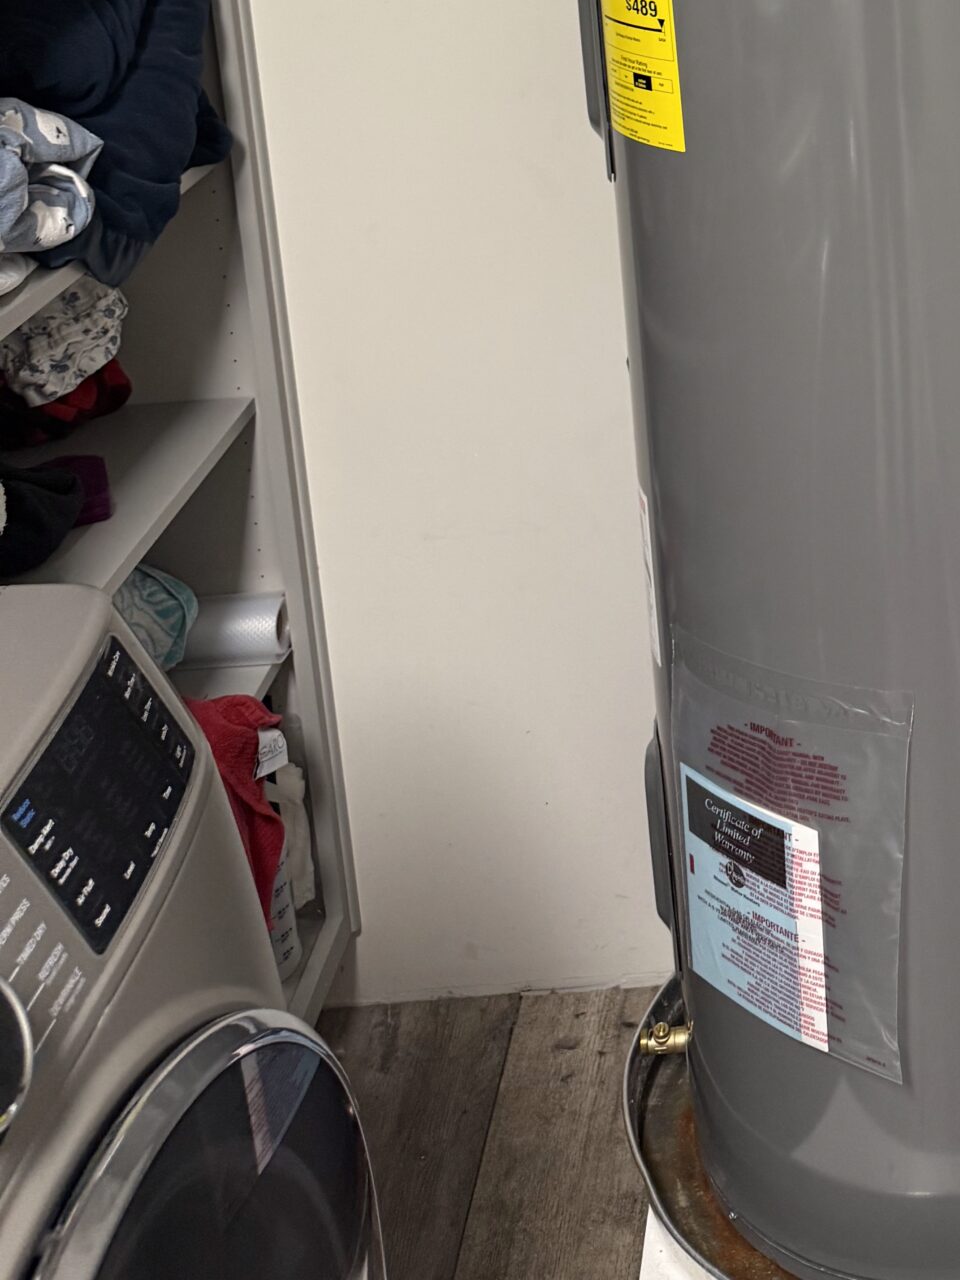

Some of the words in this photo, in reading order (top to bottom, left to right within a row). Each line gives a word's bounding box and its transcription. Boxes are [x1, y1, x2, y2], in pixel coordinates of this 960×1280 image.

[750, 722, 794, 747] IMPORTANT
[705, 798, 750, 832] Certificate
[752, 828, 764, 839] of
[716, 820, 750, 846] Limited
[28, 834, 45, 855] Damp
[41, 818, 55, 836] Alert
[714, 832, 755, 864] Warranty
[50, 858, 67, 878] Delay
[62, 846, 74, 861] Dry
[76, 893, 86, 906] Air
[82, 878, 95, 896] Fluff
[10, 898, 31, 925] PRESS
[94, 903, 111, 927] Sound
[752, 910, 799, 943] IMPORTANTE
[16, 937, 37, 965] TIMED
[34, 920, 47, 941] DRY
[38, 941, 64, 981] REFRESH
